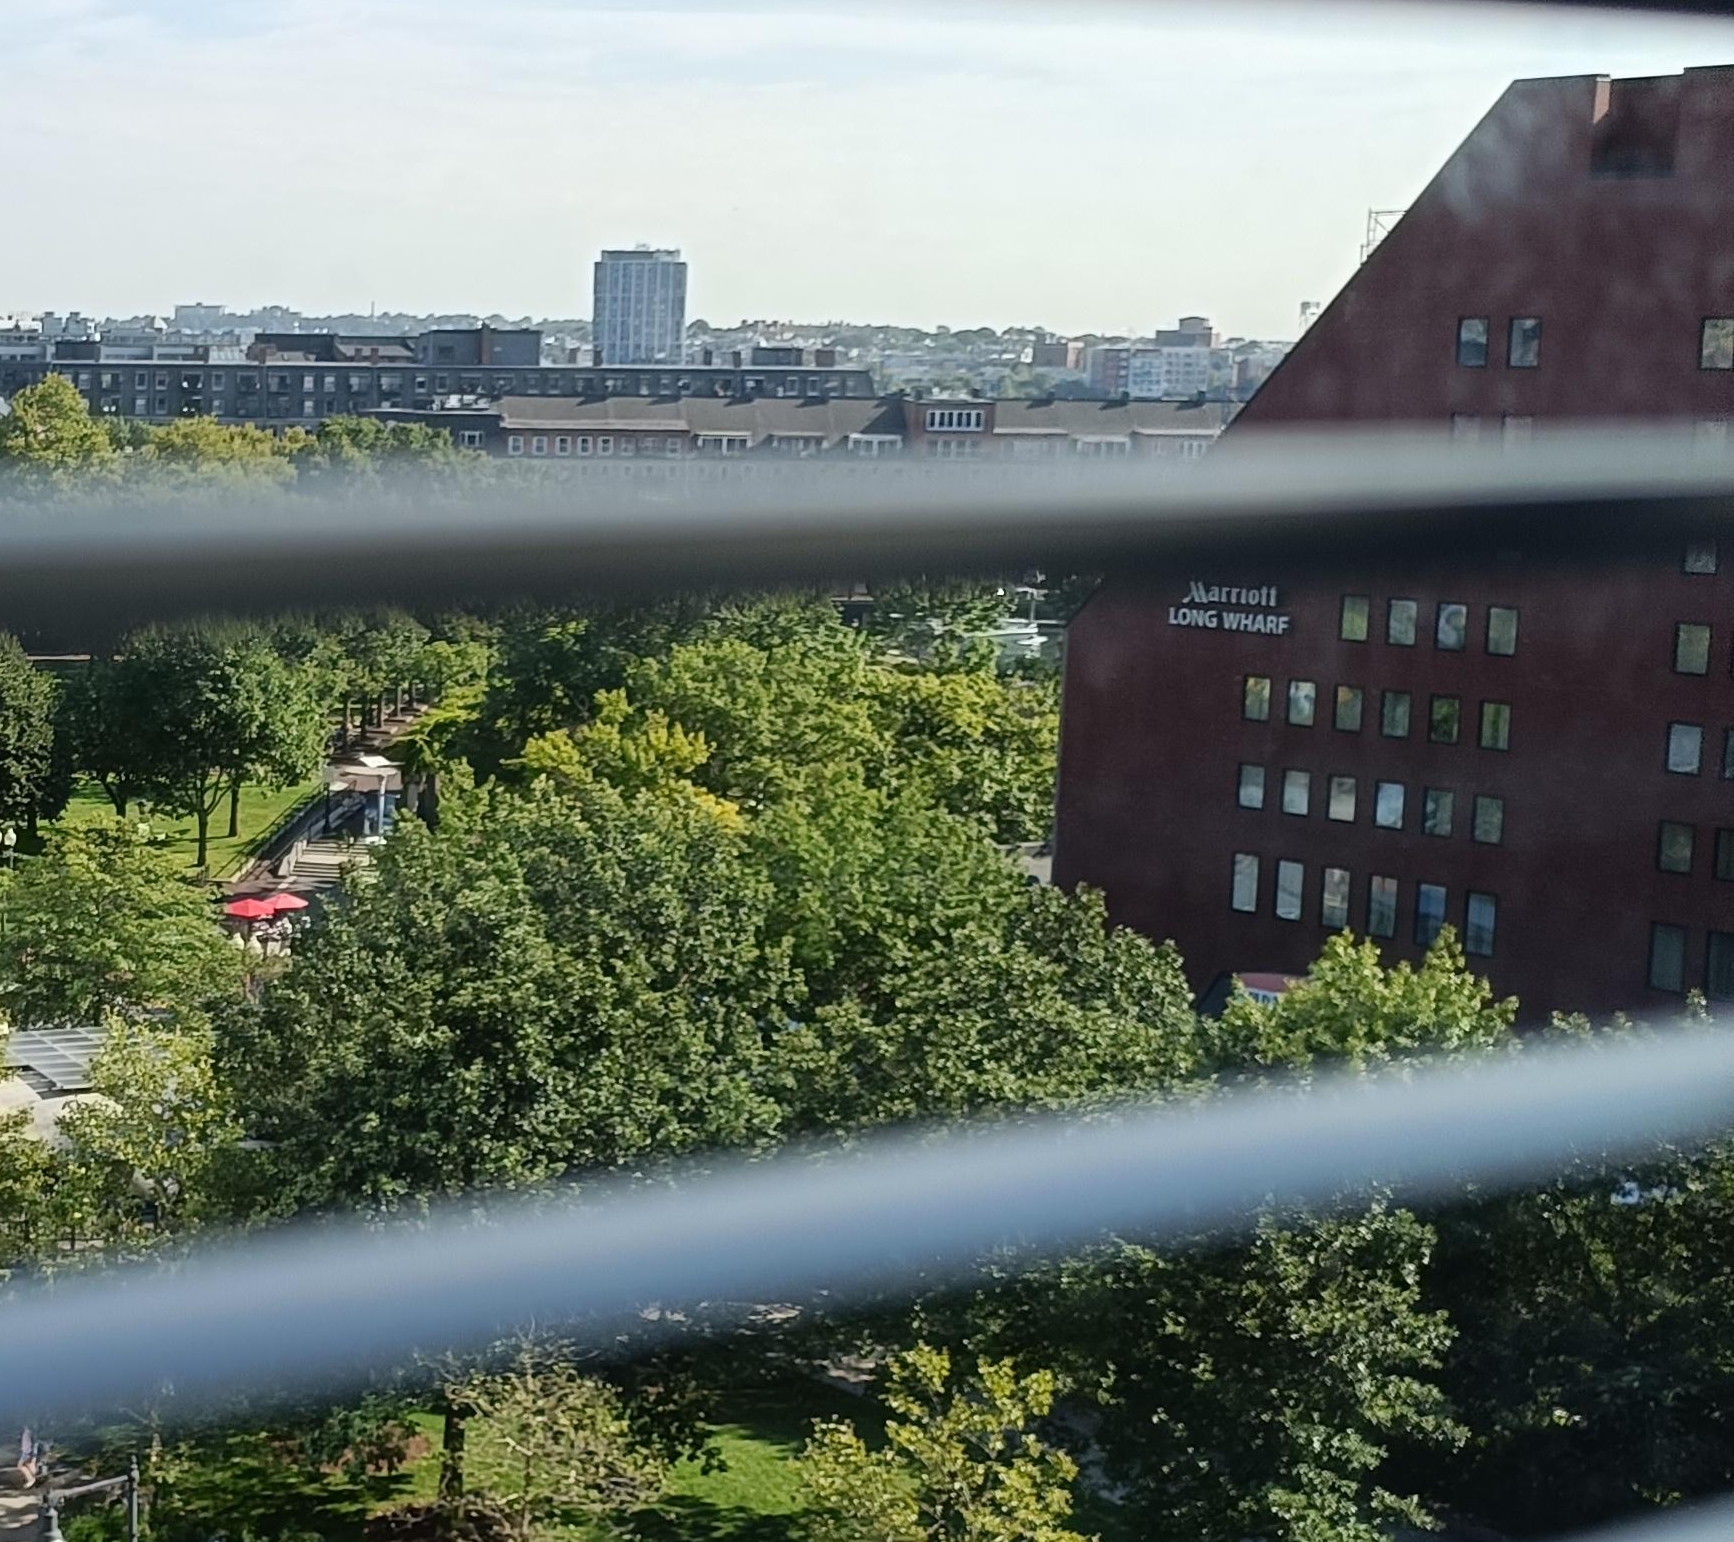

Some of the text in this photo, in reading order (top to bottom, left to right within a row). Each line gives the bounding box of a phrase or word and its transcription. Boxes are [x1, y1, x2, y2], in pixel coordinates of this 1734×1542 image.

[1182, 581, 1277, 607] Marriott
[1168, 607, 1290, 635] LONG WHARF
